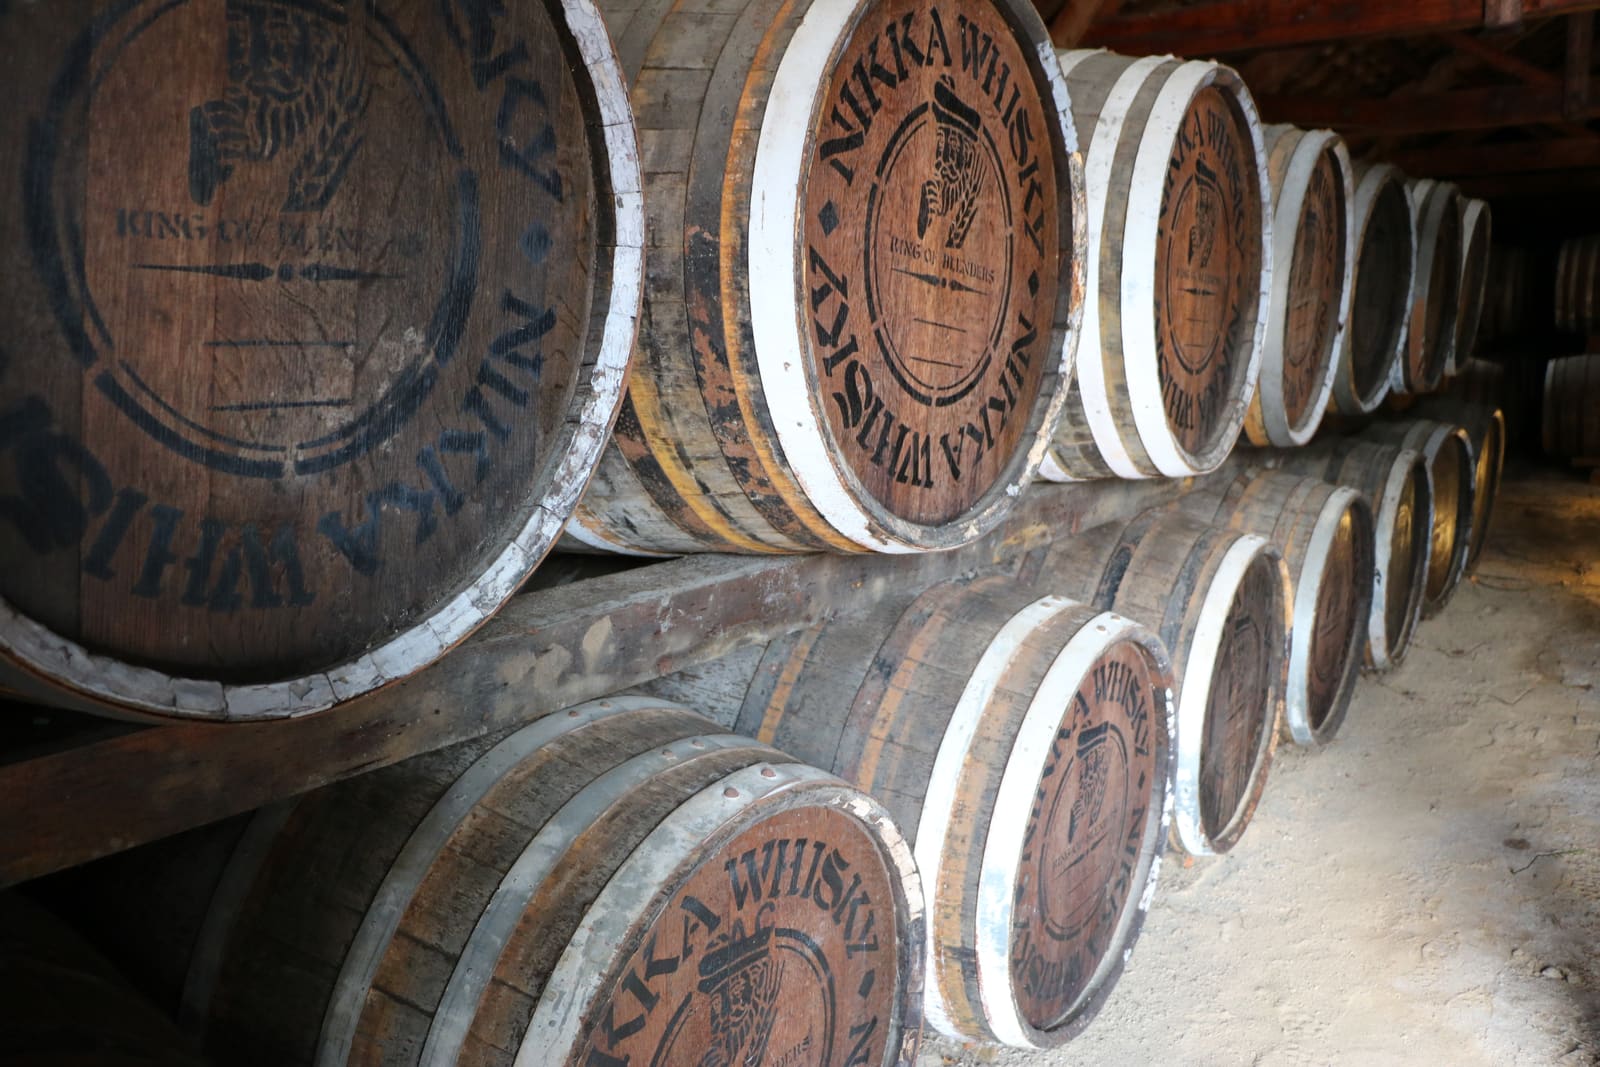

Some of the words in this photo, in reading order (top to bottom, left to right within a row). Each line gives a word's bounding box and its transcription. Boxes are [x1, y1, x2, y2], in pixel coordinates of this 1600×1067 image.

[820, 6, 952, 186] NIKKA
[957, 14, 1045, 259] WHISKY
[115, 207, 207, 242] KING
[890, 236, 921, 260] KING
[942, 253, 995, 284] BLENDERS
[317, 288, 557, 577] NIKKA
[809, 243, 934, 489] WHISKY
[940, 311, 1039, 481] NIKKA
[1093, 661, 1150, 757] WHISKY
[724, 838, 880, 959] WHISKY
